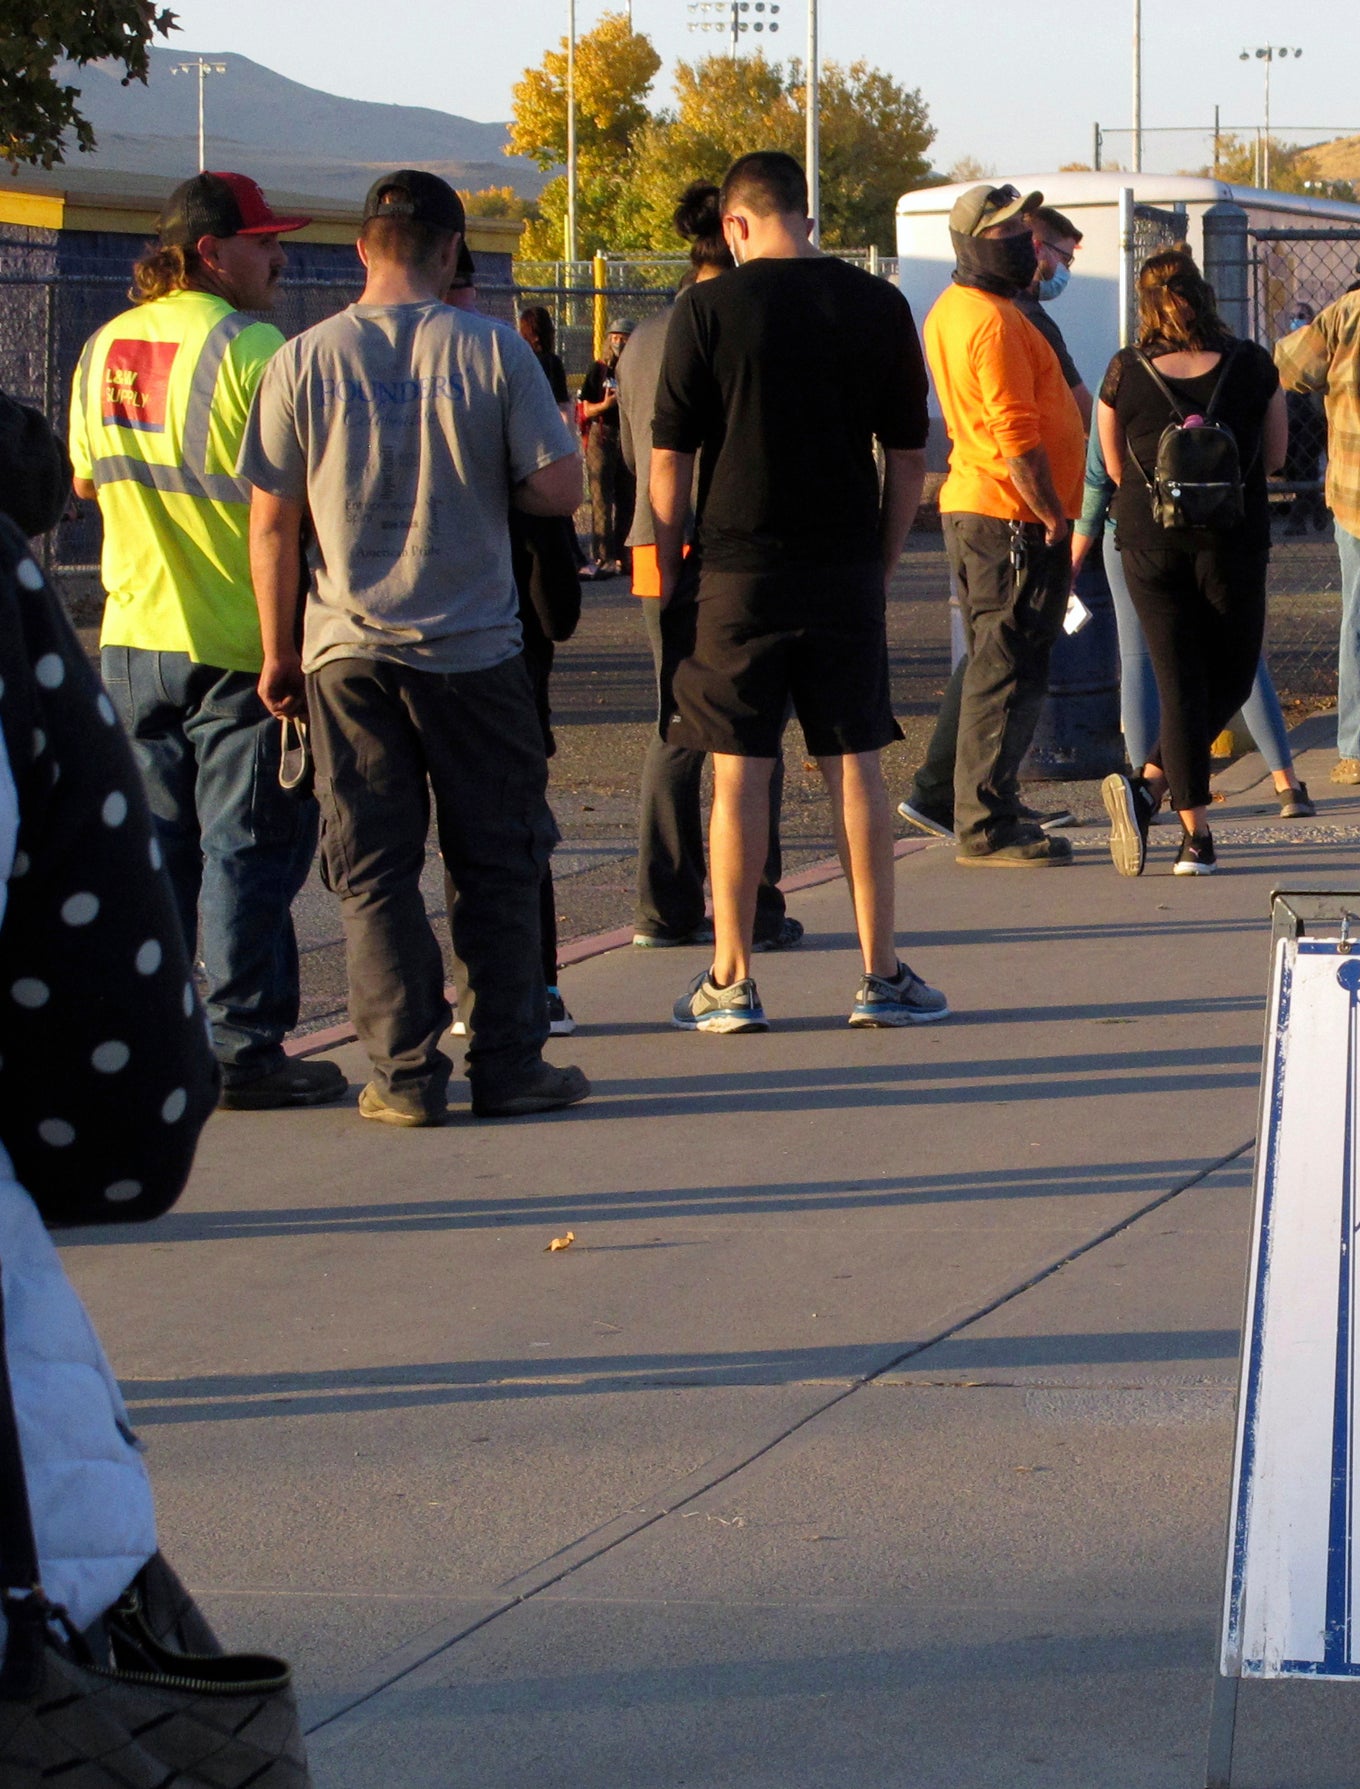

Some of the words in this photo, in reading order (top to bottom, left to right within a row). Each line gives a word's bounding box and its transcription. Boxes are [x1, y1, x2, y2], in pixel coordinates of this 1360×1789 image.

[106, 368, 138, 385] L&W
[106, 387, 149, 407] SUPPLY
[320, 373, 464, 406] FOUNDERS
